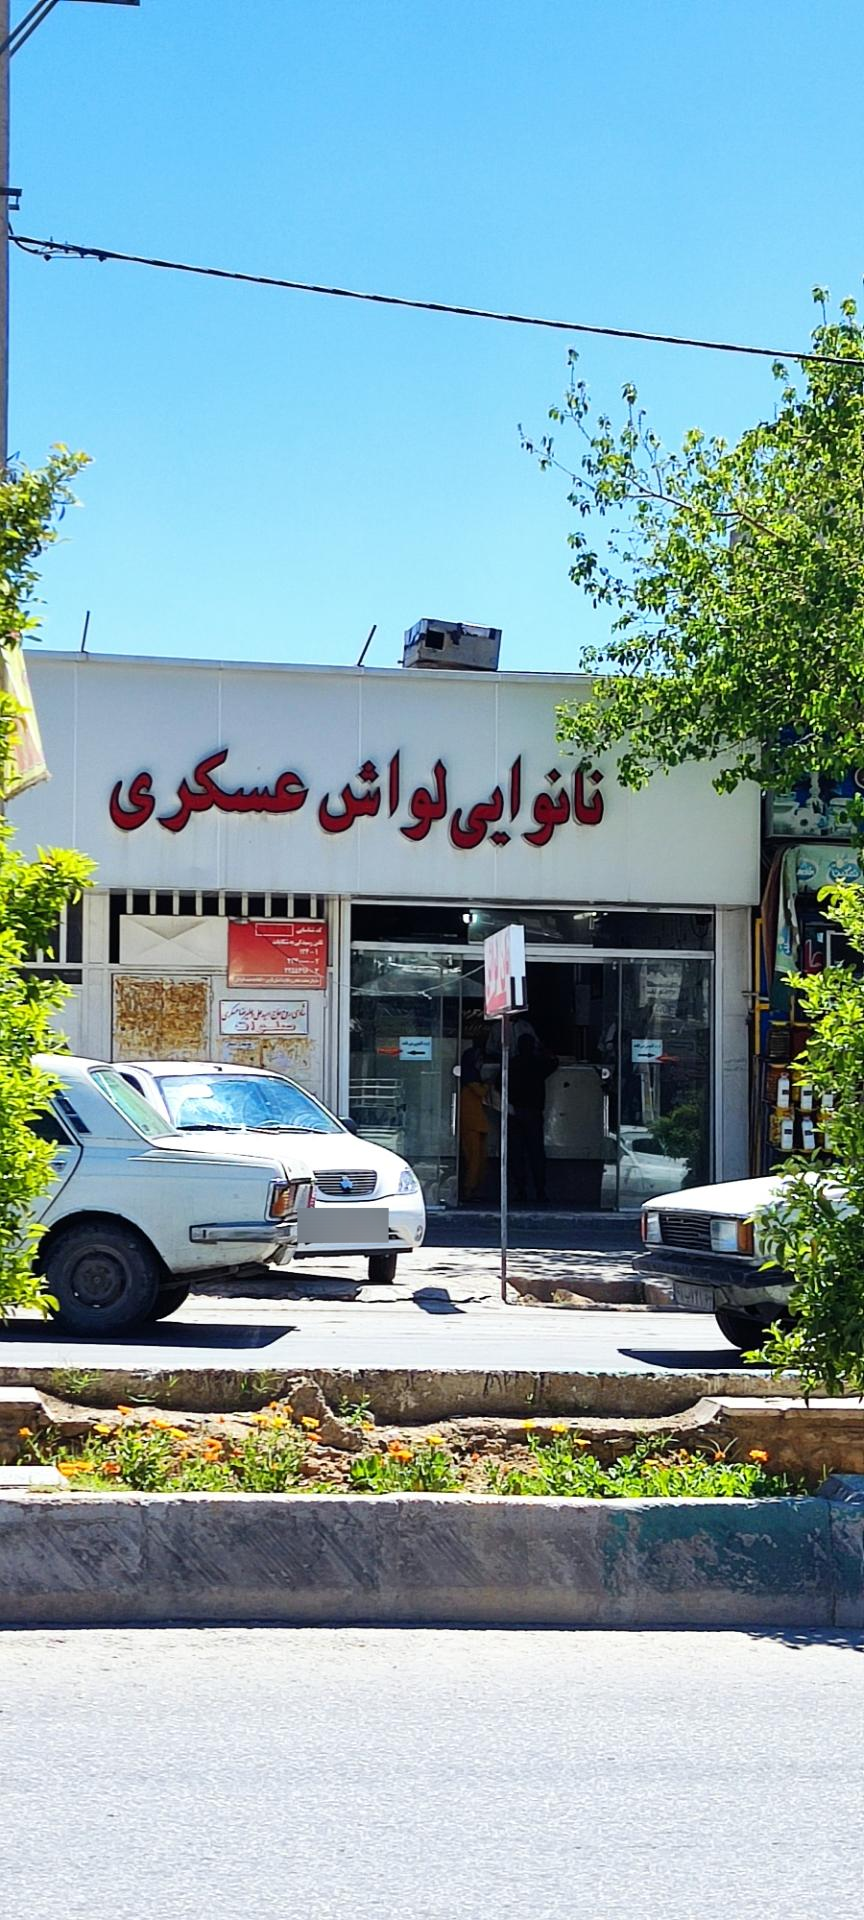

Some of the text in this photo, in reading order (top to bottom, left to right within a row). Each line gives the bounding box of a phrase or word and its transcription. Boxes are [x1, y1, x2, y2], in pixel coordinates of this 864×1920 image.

[109, 748, 605, 849] نانوایی لواش عسکری
